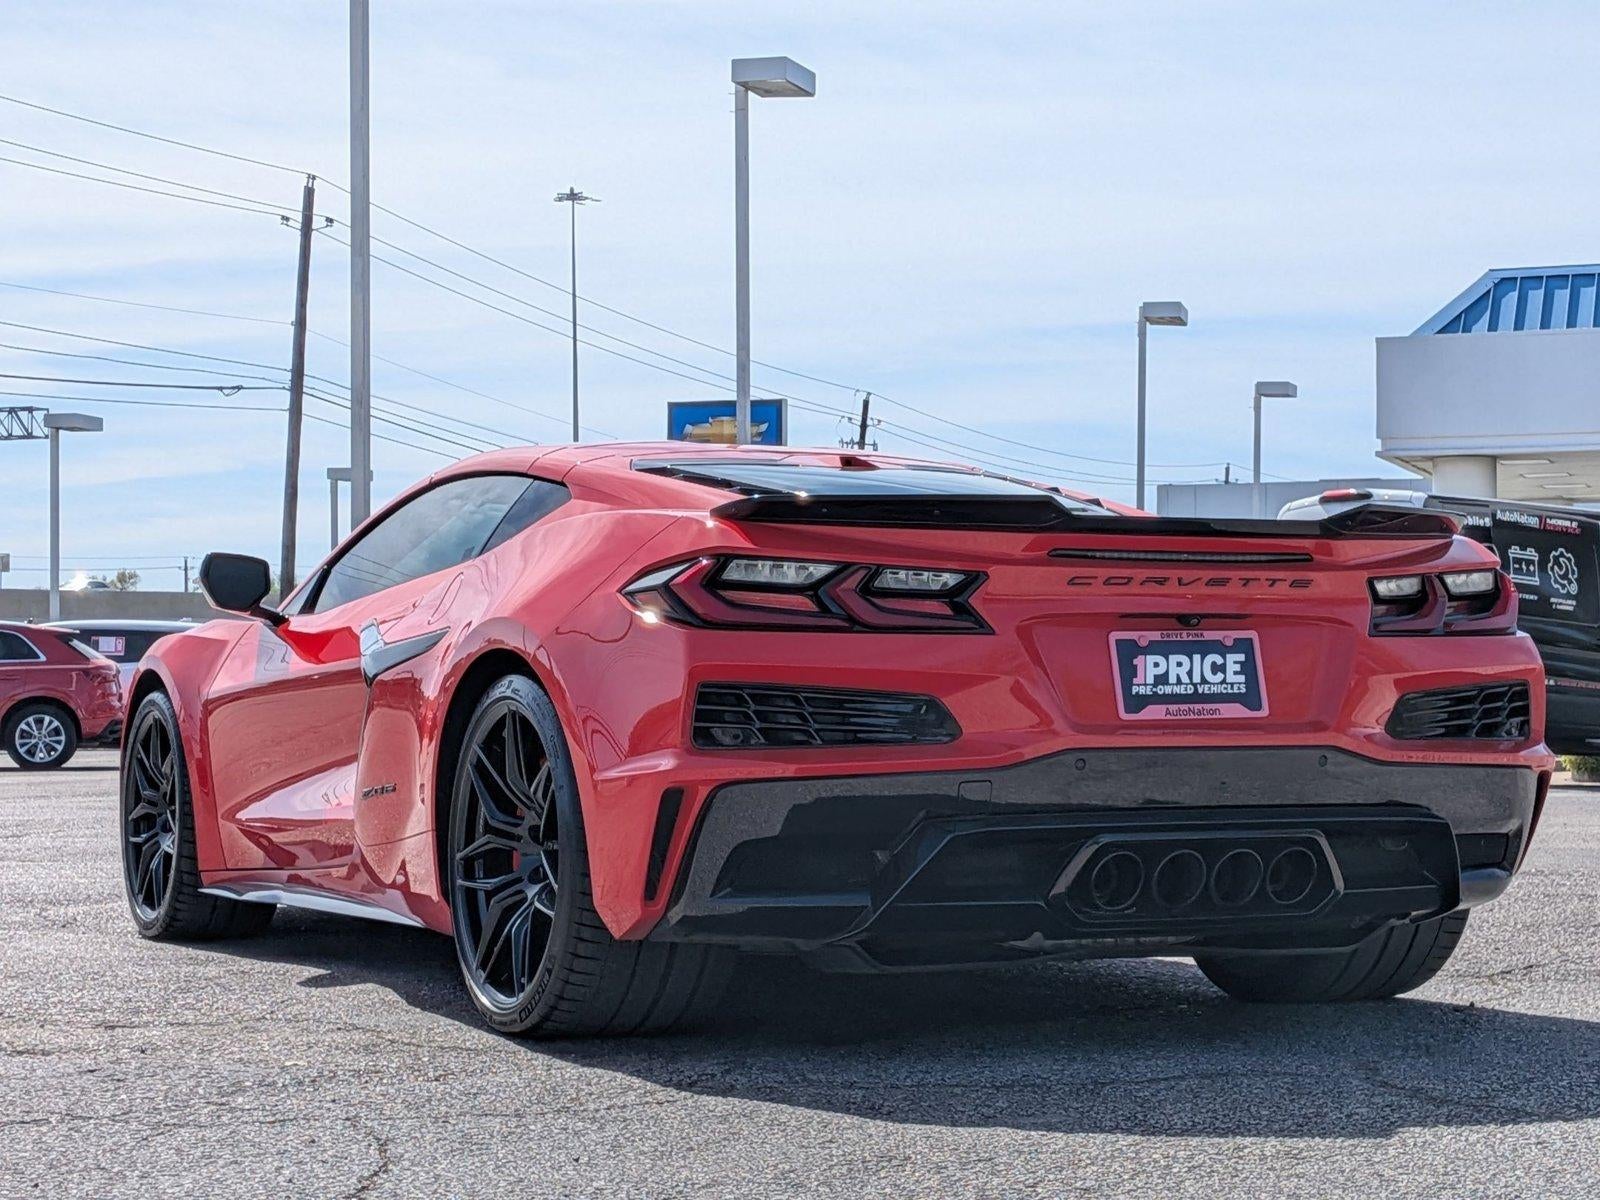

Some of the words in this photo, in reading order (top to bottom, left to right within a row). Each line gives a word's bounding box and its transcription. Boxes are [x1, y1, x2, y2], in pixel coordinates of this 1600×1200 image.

[1496, 510, 1539, 528] AutoNation
[1066, 576, 1314, 588] CORVETTE
[1132, 653, 1246, 685] 1PRICE
[1131, 684, 1194, 695] PRE-OWNED
[1197, 683, 1246, 694] VEHICLES
[1164, 706, 1221, 717] AutoNation
